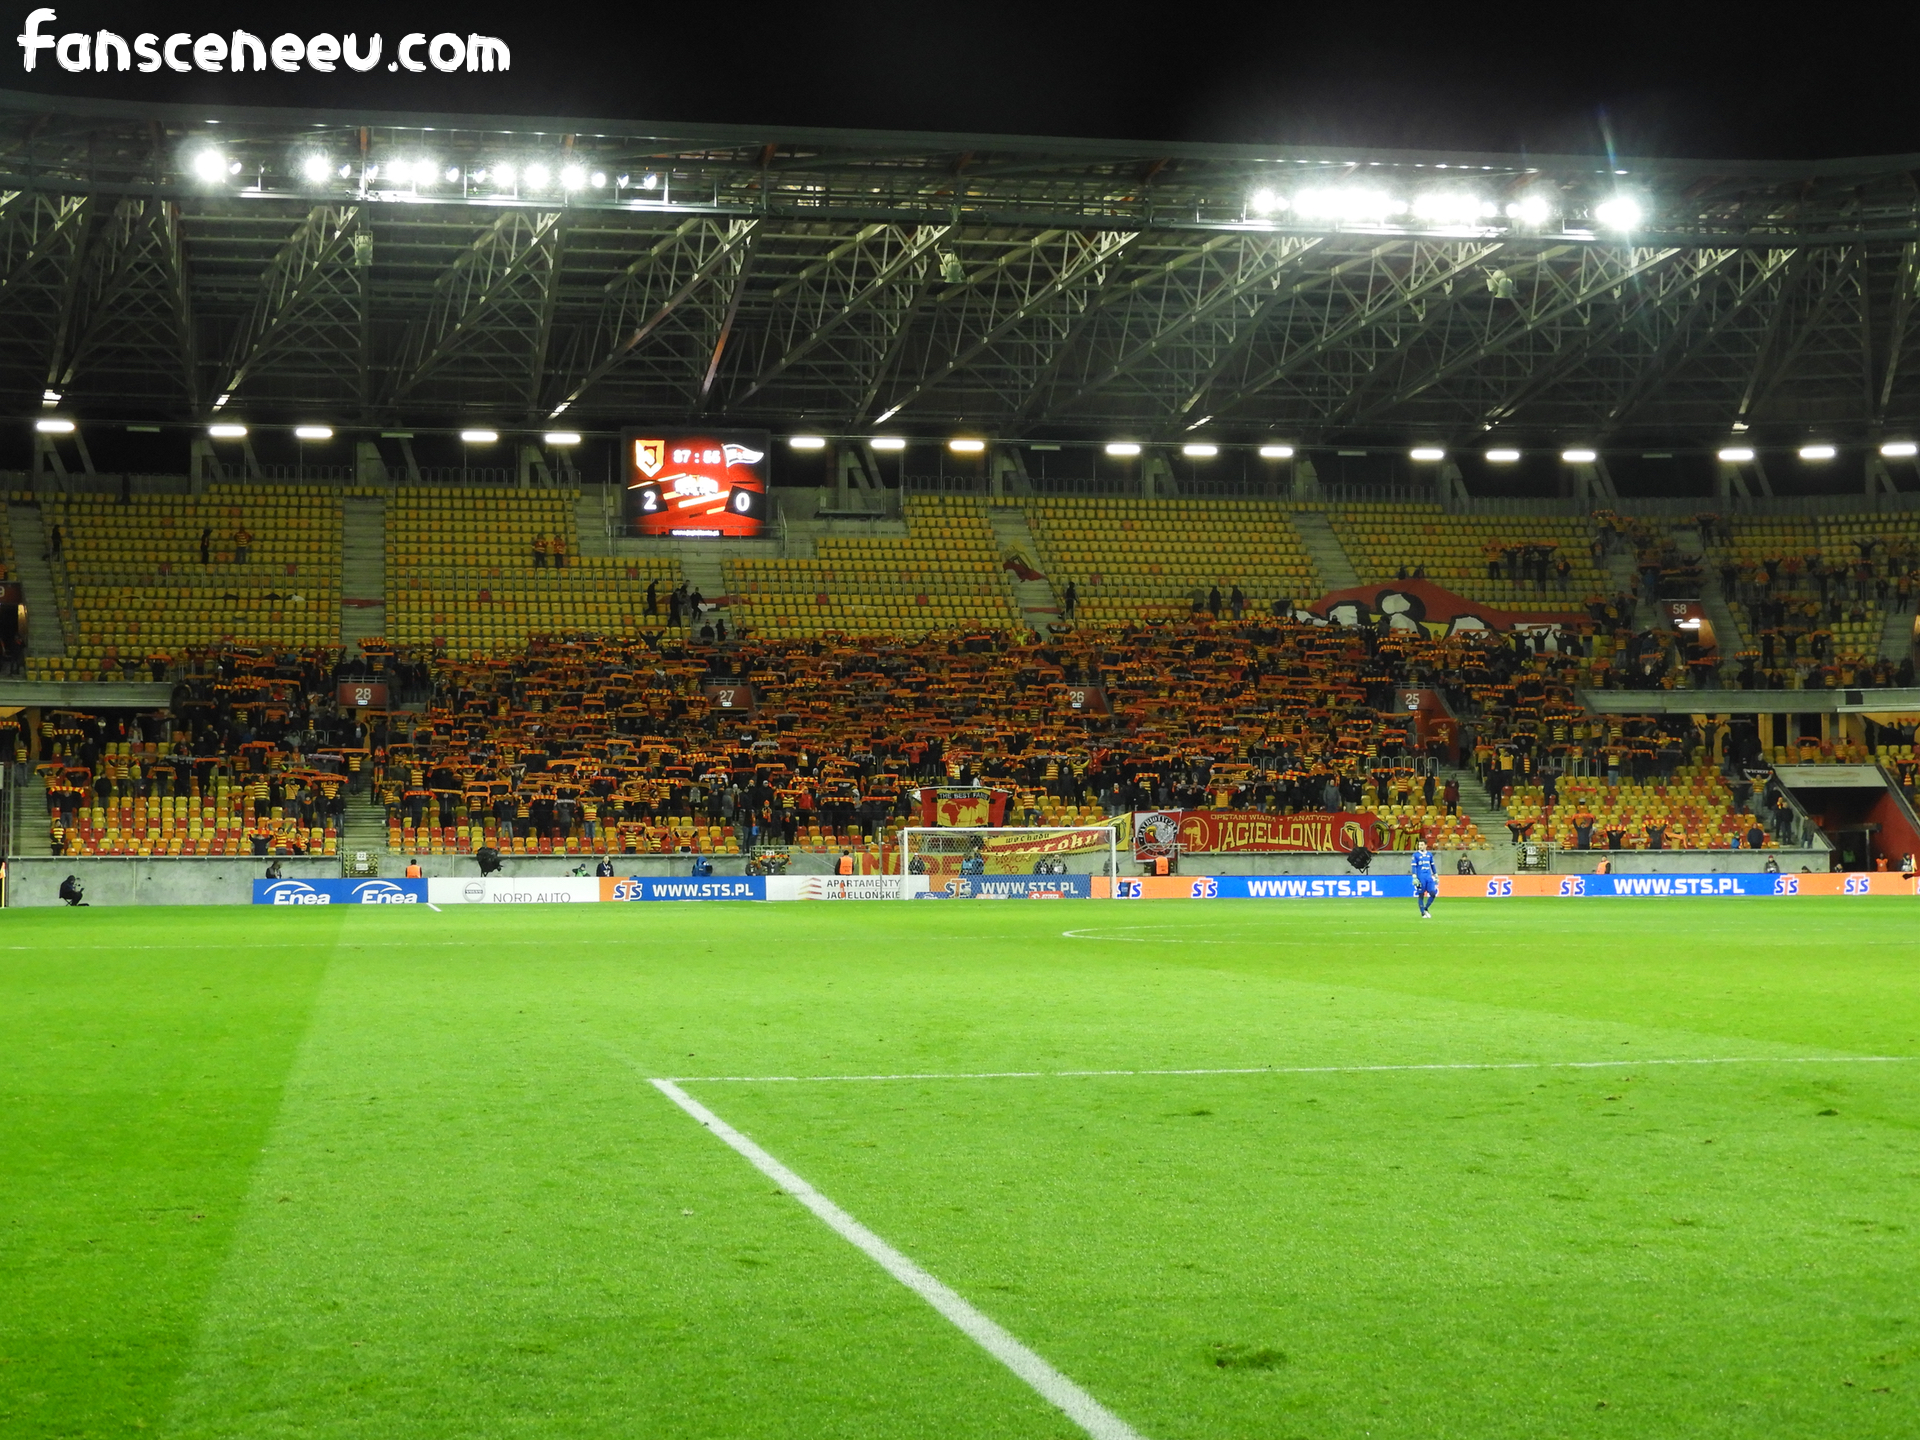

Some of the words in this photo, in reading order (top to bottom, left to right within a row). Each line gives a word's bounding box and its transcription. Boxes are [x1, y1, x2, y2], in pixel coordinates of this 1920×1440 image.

[643, 490, 658, 511] 2
[735, 492, 751, 512] 0
[1672, 603, 1687, 615] 58
[355, 688, 372, 700] 28
[719, 690, 735, 702] 27
[1069, 691, 1085, 703] 26
[1405, 693, 1420, 705] 25
[1210, 821, 1335, 852] JAGIELLONIA
[612, 880, 643, 902] STS
[652, 884, 754, 897] WWW.STS.PL
[827, 879, 901, 888] APARTAMENTY
[1191, 878, 1218, 899] STS
[1248, 880, 1384, 897] WWW.STS.PL
[1487, 876, 1513, 897] STS
[1559, 876, 1585, 897] STS
[1613, 878, 1745, 894] WWW.STS.PL
[1774, 875, 1799, 895] STS
[1844, 873, 1870, 895] STS
[274, 890, 331, 905] Enea
[361, 889, 418, 904] Enea
[493, 892, 532, 903] NORD
[537, 892, 571, 903] AUTO
